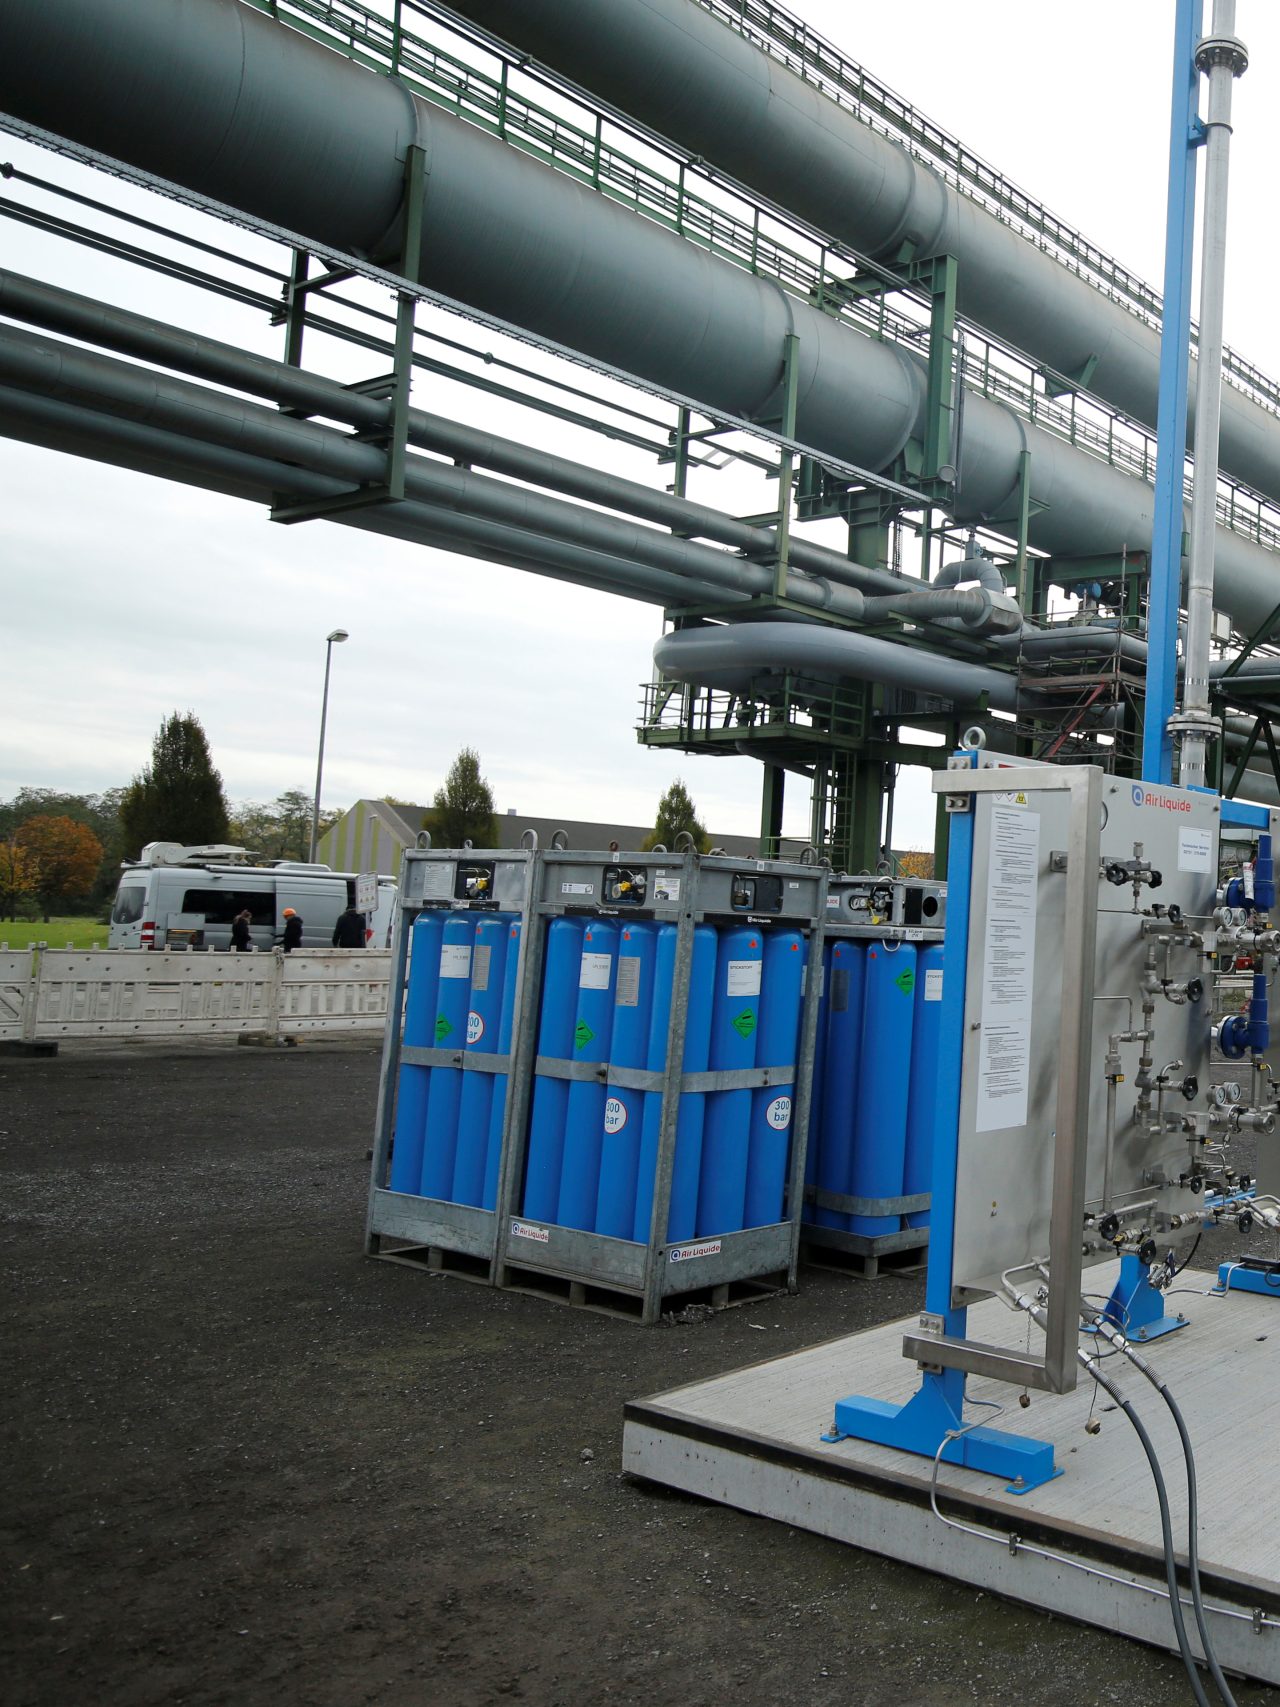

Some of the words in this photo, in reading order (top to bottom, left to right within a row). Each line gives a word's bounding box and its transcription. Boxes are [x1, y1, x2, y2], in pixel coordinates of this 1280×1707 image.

[1145, 793, 1160, 807] Air
[1160, 795, 1191, 812] Liquide
[468, 1016, 480, 1027] 00
[468, 1030, 478, 1039] ar
[775, 1100, 790, 1110] 300
[774, 1112, 788, 1121] bar
[528, 1229, 549, 1240] Liquide
[681, 1250, 692, 1258] Air
[693, 1245, 721, 1256] Liquide
